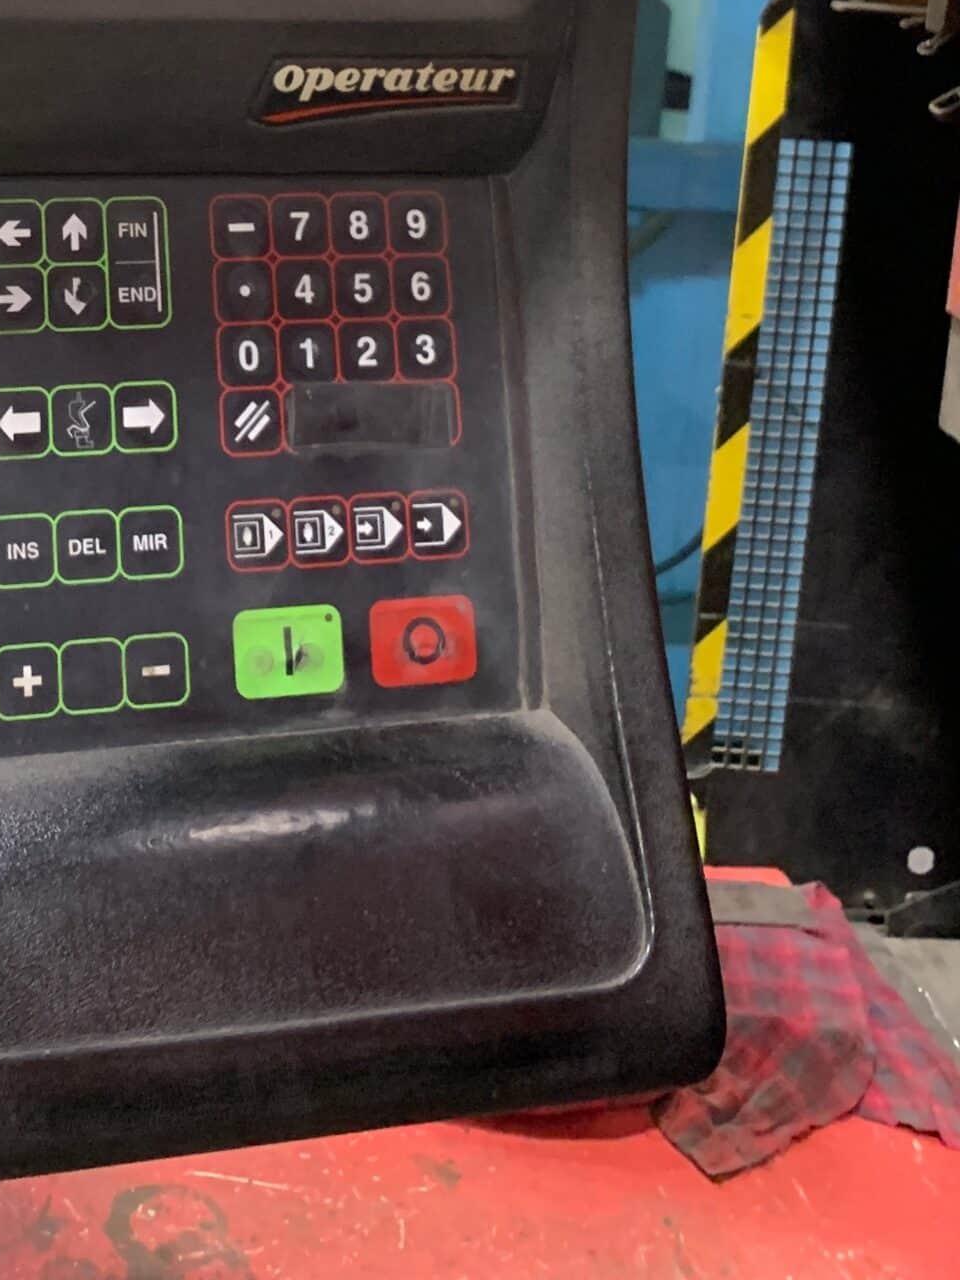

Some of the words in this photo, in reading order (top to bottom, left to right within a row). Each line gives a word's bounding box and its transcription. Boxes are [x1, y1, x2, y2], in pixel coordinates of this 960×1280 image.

[117, 222, 148, 238] FIN
[289, 211, 311, 241] 7
[348, 210, 370, 240] 8
[405, 208, 427, 239] 9
[118, 286, 157, 303] END
[294, 274, 315, 304] 4
[353, 272, 374, 304] 5
[410, 271, 432, 302] 6
[238, 339, 260, 372] 0
[298, 337, 316, 369] 1
[356, 335, 378, 367] 2
[415, 333, 436, 366] 3
[6, 541, 40, 561] INS
[67, 537, 107, 557] DEL
[132, 532, 169, 553] MIR
